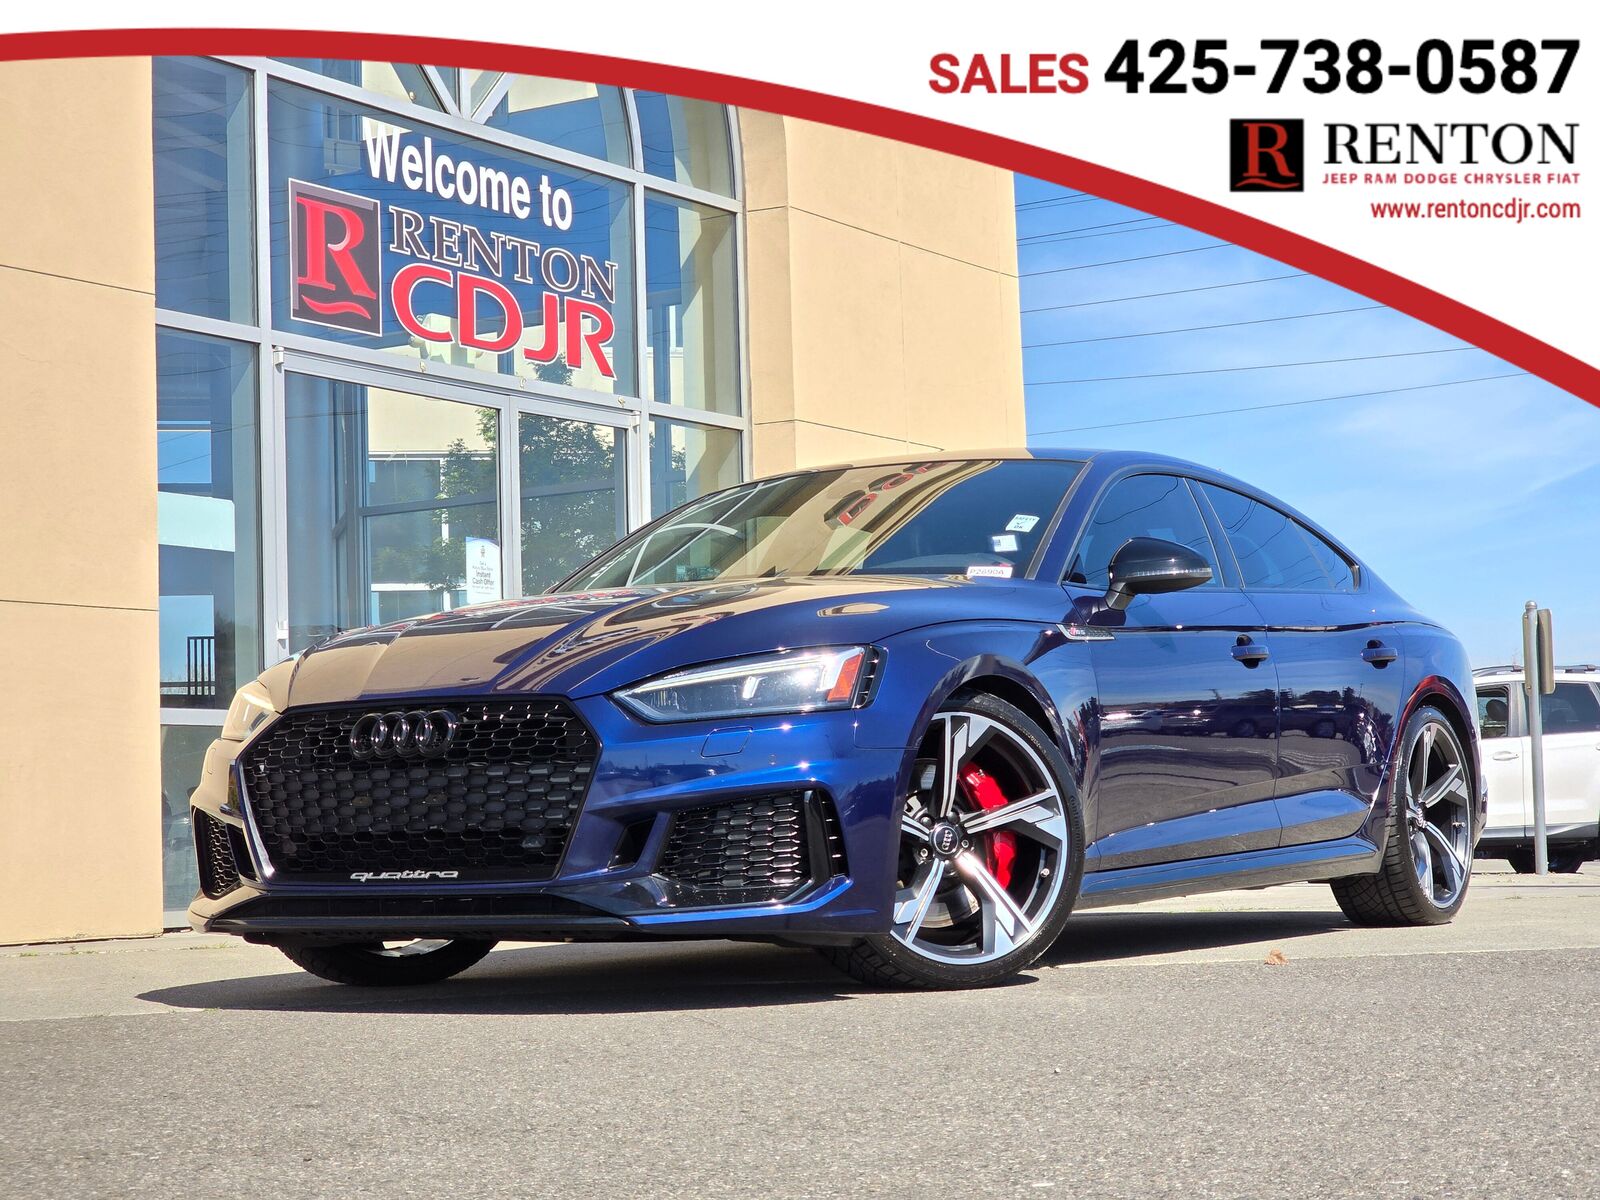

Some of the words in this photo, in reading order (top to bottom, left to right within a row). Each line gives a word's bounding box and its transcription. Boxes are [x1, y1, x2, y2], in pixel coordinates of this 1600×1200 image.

[362, 116, 531, 220] Welcome
[539, 174, 573, 231] to
[296, 196, 376, 299] R
[389, 205, 618, 303] RENTON
[391, 262, 617, 380] CDJR
[350, 870, 459, 882] quattro
